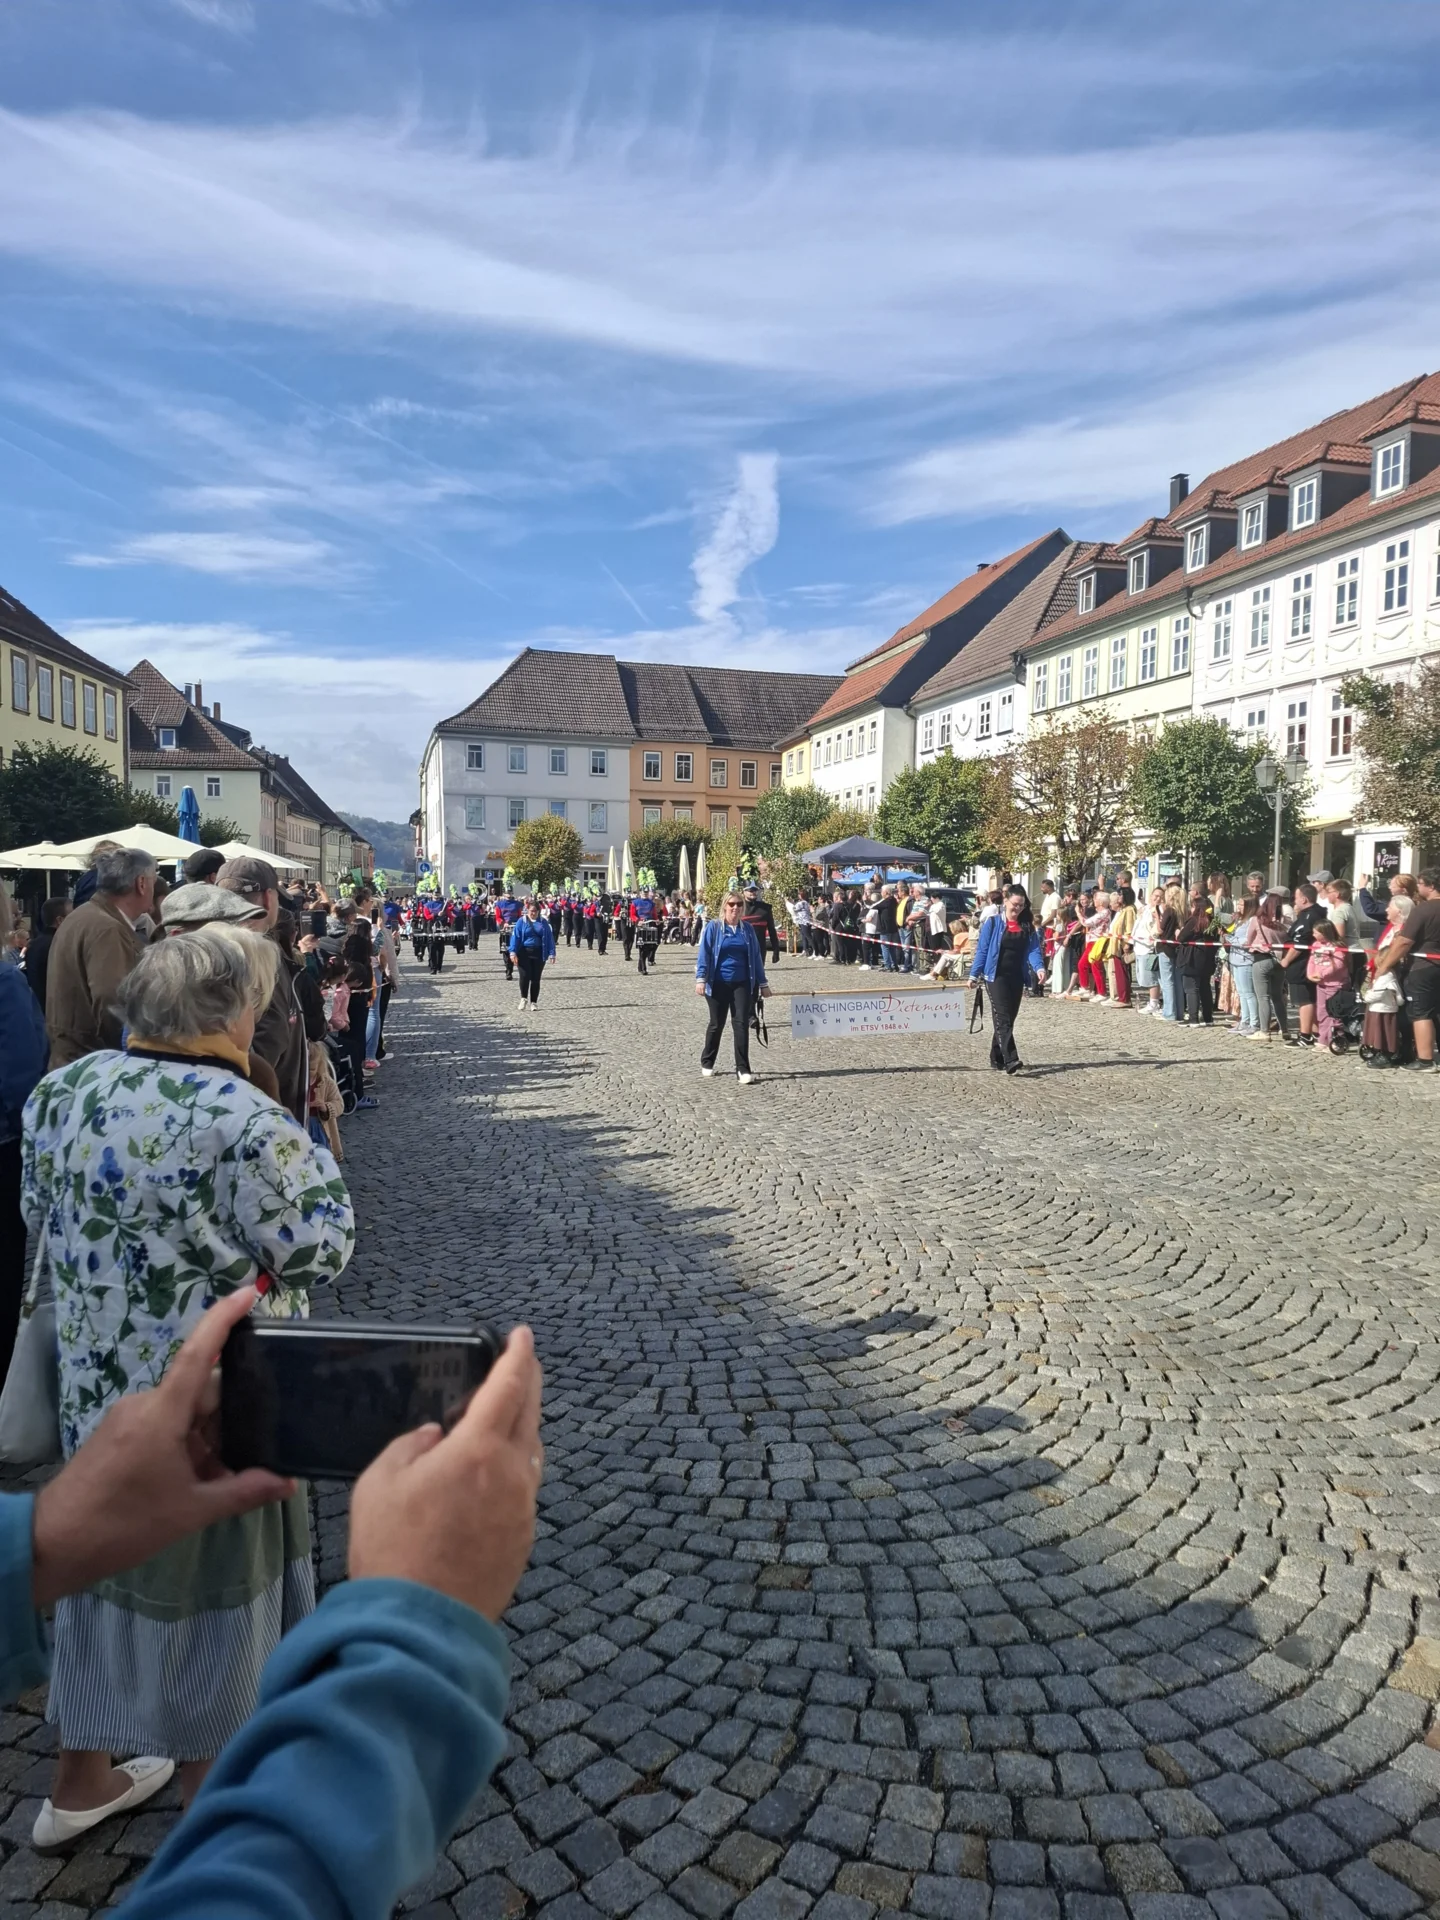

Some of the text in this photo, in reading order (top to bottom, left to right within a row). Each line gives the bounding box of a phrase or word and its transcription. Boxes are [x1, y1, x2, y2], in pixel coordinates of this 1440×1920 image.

[1140, 862, 1147, 876] P
[795, 994, 961, 1014] MARCHINGBAND Dietemann
[796, 1015, 895, 1026] ESCHWEGE
[860, 1024, 879, 1032] ETSV
[881, 1023, 897, 1031] 1848
[897, 1022, 910, 1030] e.V.
